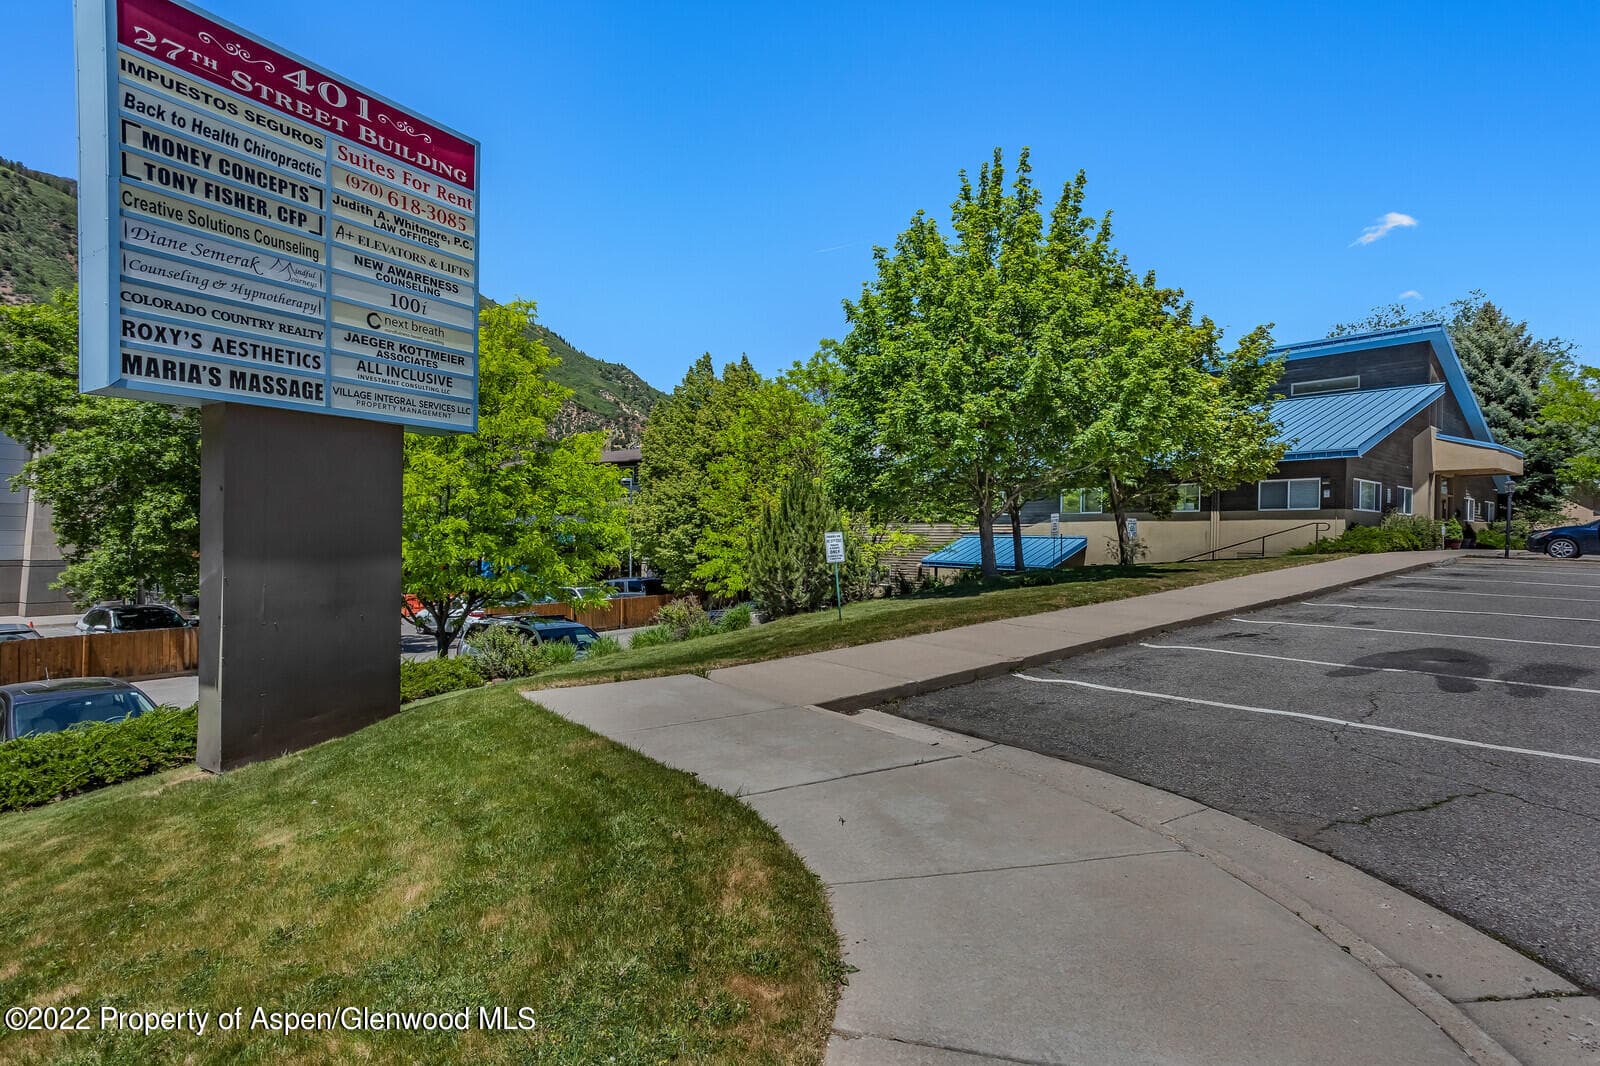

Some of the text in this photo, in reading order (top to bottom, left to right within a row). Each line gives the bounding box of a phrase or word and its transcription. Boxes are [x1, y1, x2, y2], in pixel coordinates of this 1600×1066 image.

[120, 58, 323, 149] IMPUESTOS SEGUROS
[283, 69, 372, 122] 401
[124, 92, 322, 178] Back to Health Chiropractic
[231, 70, 349, 132] STREET
[358, 124, 467, 183] BUILDING
[142, 131, 309, 203] MONEY CONCEPTS
[338, 145, 472, 211] Suites For Rent
[144, 162, 307, 228] TONY FISHER, CFP
[346, 174, 466, 231] (970) 618-3085
[122, 191, 319, 262] Creative Solutions Counseling
[332, 195, 473, 250] Judith A. Whitmore, P.C.
[374, 220, 440, 248] LAW OFFICES
[131, 226, 264, 275] Diane Semerak
[336, 225, 470, 278] A+ ELEVATORS & LIFTS
[354, 255, 459, 294] NEW AWARENESS
[129, 259, 318, 315] Counseling & Hypnotherapy
[376, 273, 441, 297] COUNSELING
[121, 291, 324, 340] COLORADO COUNTRY REALTY
[384, 317, 408, 332] next
[412, 321, 445, 338] breath
[212, 337, 321, 370] AESTHETICS
[344, 333, 394, 350] JAEGER
[400, 344, 465, 365] KOTTMEIER
[376, 351, 438, 369] ASSOCIATES
[230, 370, 324, 401] MASSAGE
[357, 360, 453, 388] ALL INCLUSIVE
[358, 374, 399, 386] INVESTMENT
[401, 382, 442, 393] CONSULTING
[333, 386, 372, 400] VILLAGE
[374, 394, 416, 407] INTEGRAL
[419, 400, 455, 413] SERVICES
[356, 400, 452, 418] PROPERTY MANAGEMENT
